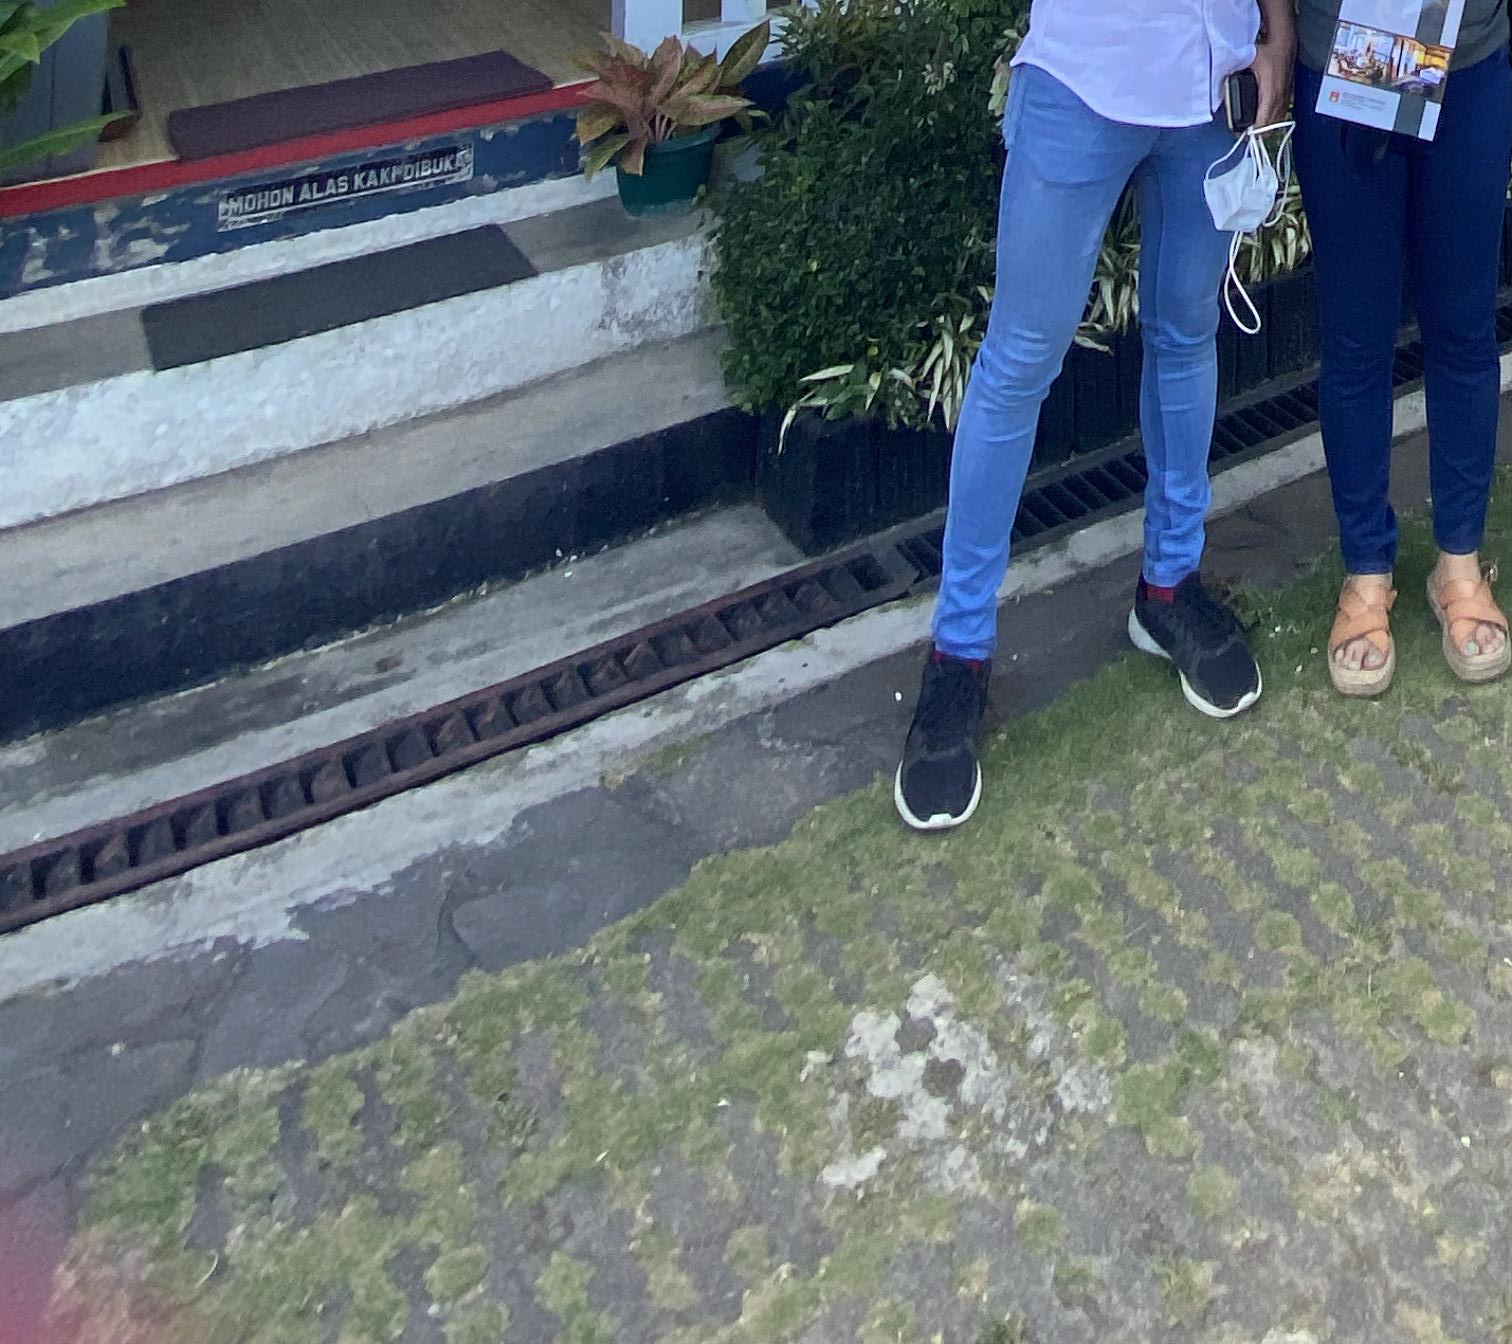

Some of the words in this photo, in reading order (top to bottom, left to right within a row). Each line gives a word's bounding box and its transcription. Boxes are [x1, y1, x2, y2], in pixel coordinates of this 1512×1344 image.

[228, 185, 294, 213] MOHON
[299, 175, 348, 202] ALAS
[353, 164, 398, 190] KAKI
[402, 152, 466, 181] DIBUKA
